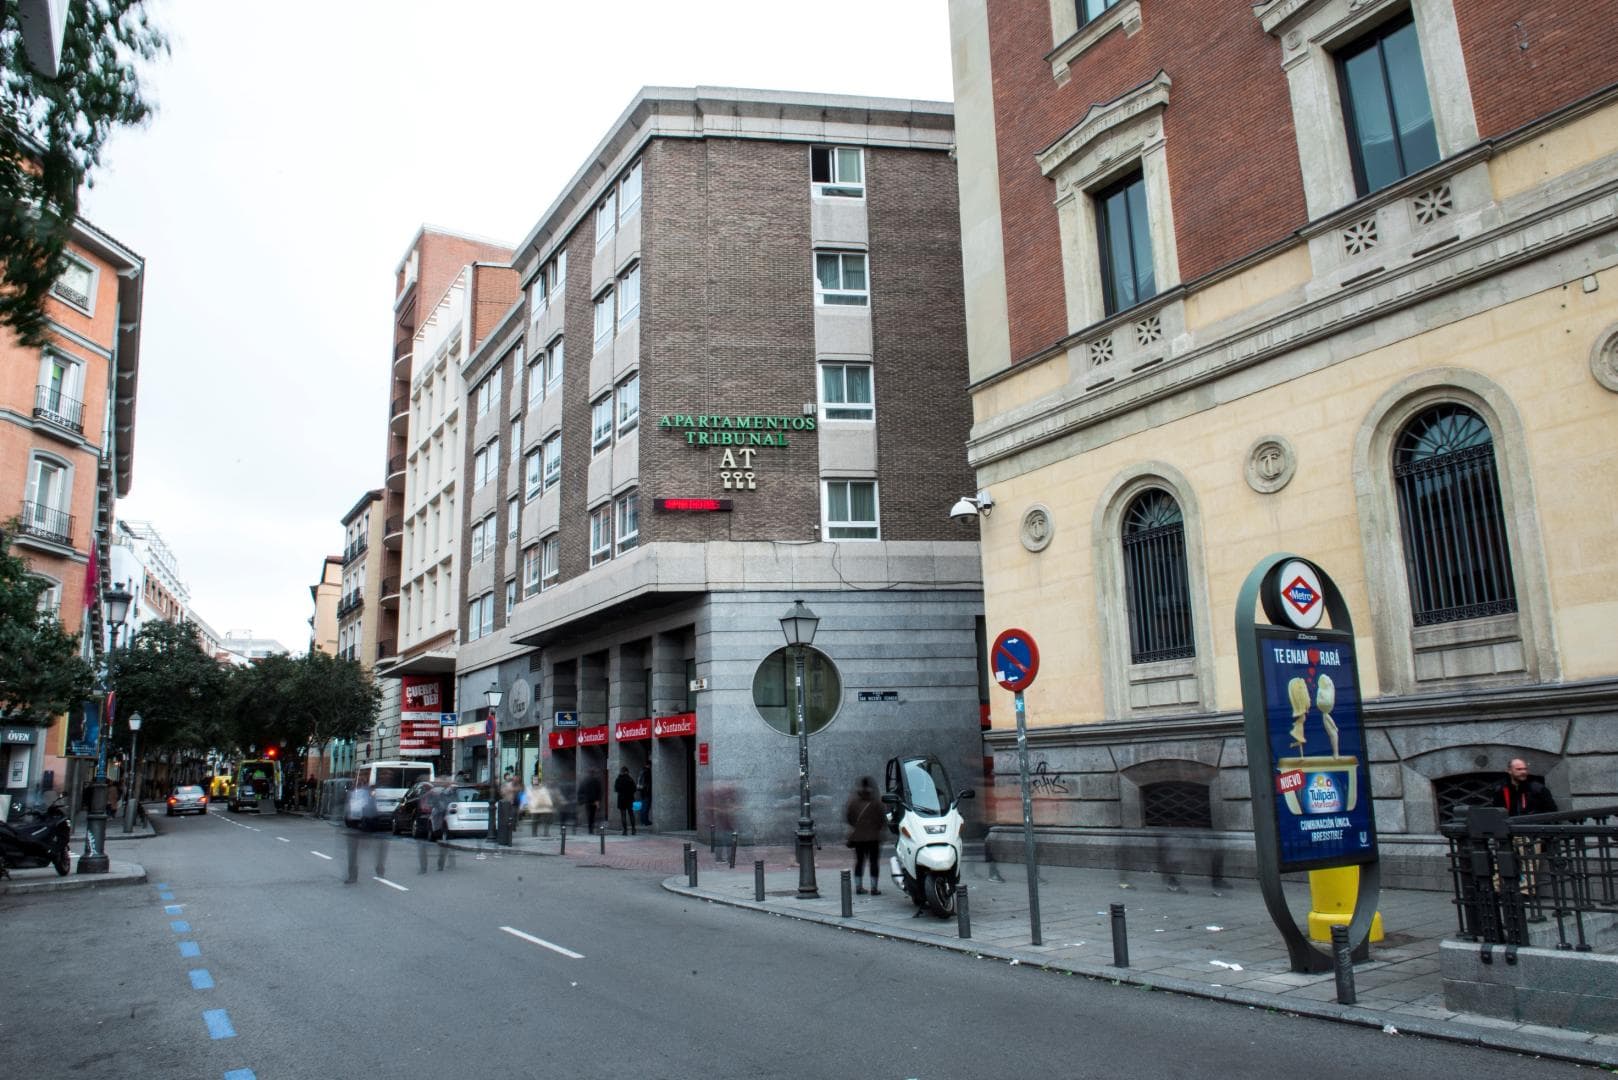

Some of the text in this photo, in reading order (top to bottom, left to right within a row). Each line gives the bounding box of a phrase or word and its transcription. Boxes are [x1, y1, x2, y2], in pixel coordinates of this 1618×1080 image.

[660, 415, 815, 430] APARTAMENTOS
[685, 431, 789, 446] TRIBUNAL
[720, 448, 756, 468] AT
[1291, 588, 1312, 601] Metro
[1274, 648, 1285, 663] TE
[406, 682, 439, 697] CUERPO
[622, 724, 648, 737] Santander
[662, 718, 691, 733] Santander
[584, 730, 605, 742] Santander
[1280, 773, 1302, 790] NUEVO
[1310, 789, 1336, 801] Tulipán
[1300, 818, 1334, 830] COMBINACIÓN
[1312, 830, 1343, 842] IRRESISTIBLE
